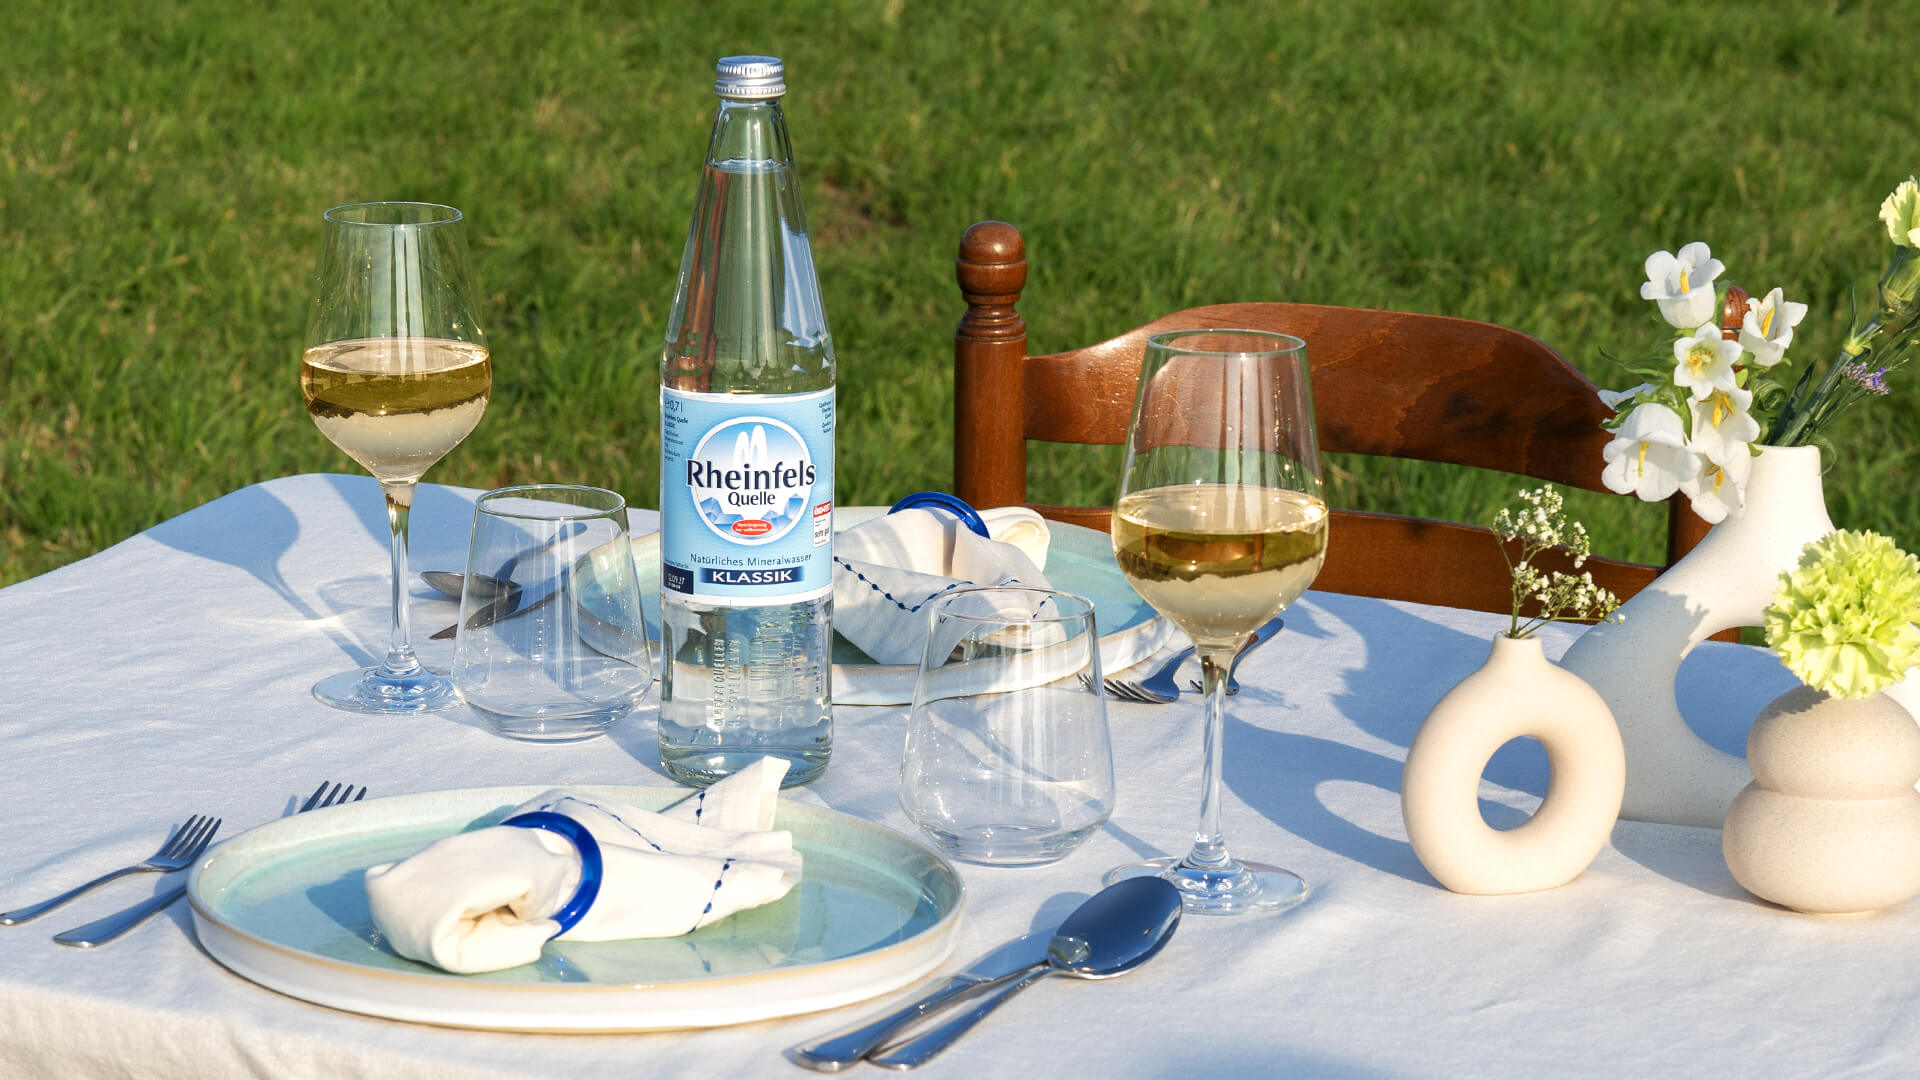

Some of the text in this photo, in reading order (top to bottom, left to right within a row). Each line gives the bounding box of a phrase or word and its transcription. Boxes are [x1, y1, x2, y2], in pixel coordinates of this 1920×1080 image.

[687, 459, 816, 490] Rheinfels
[727, 491, 776, 507] Quelle
[690, 553, 744, 567] Natürliches
[747, 552, 812, 566] Mineralwasser
[712, 569, 793, 583] KLASSIK
